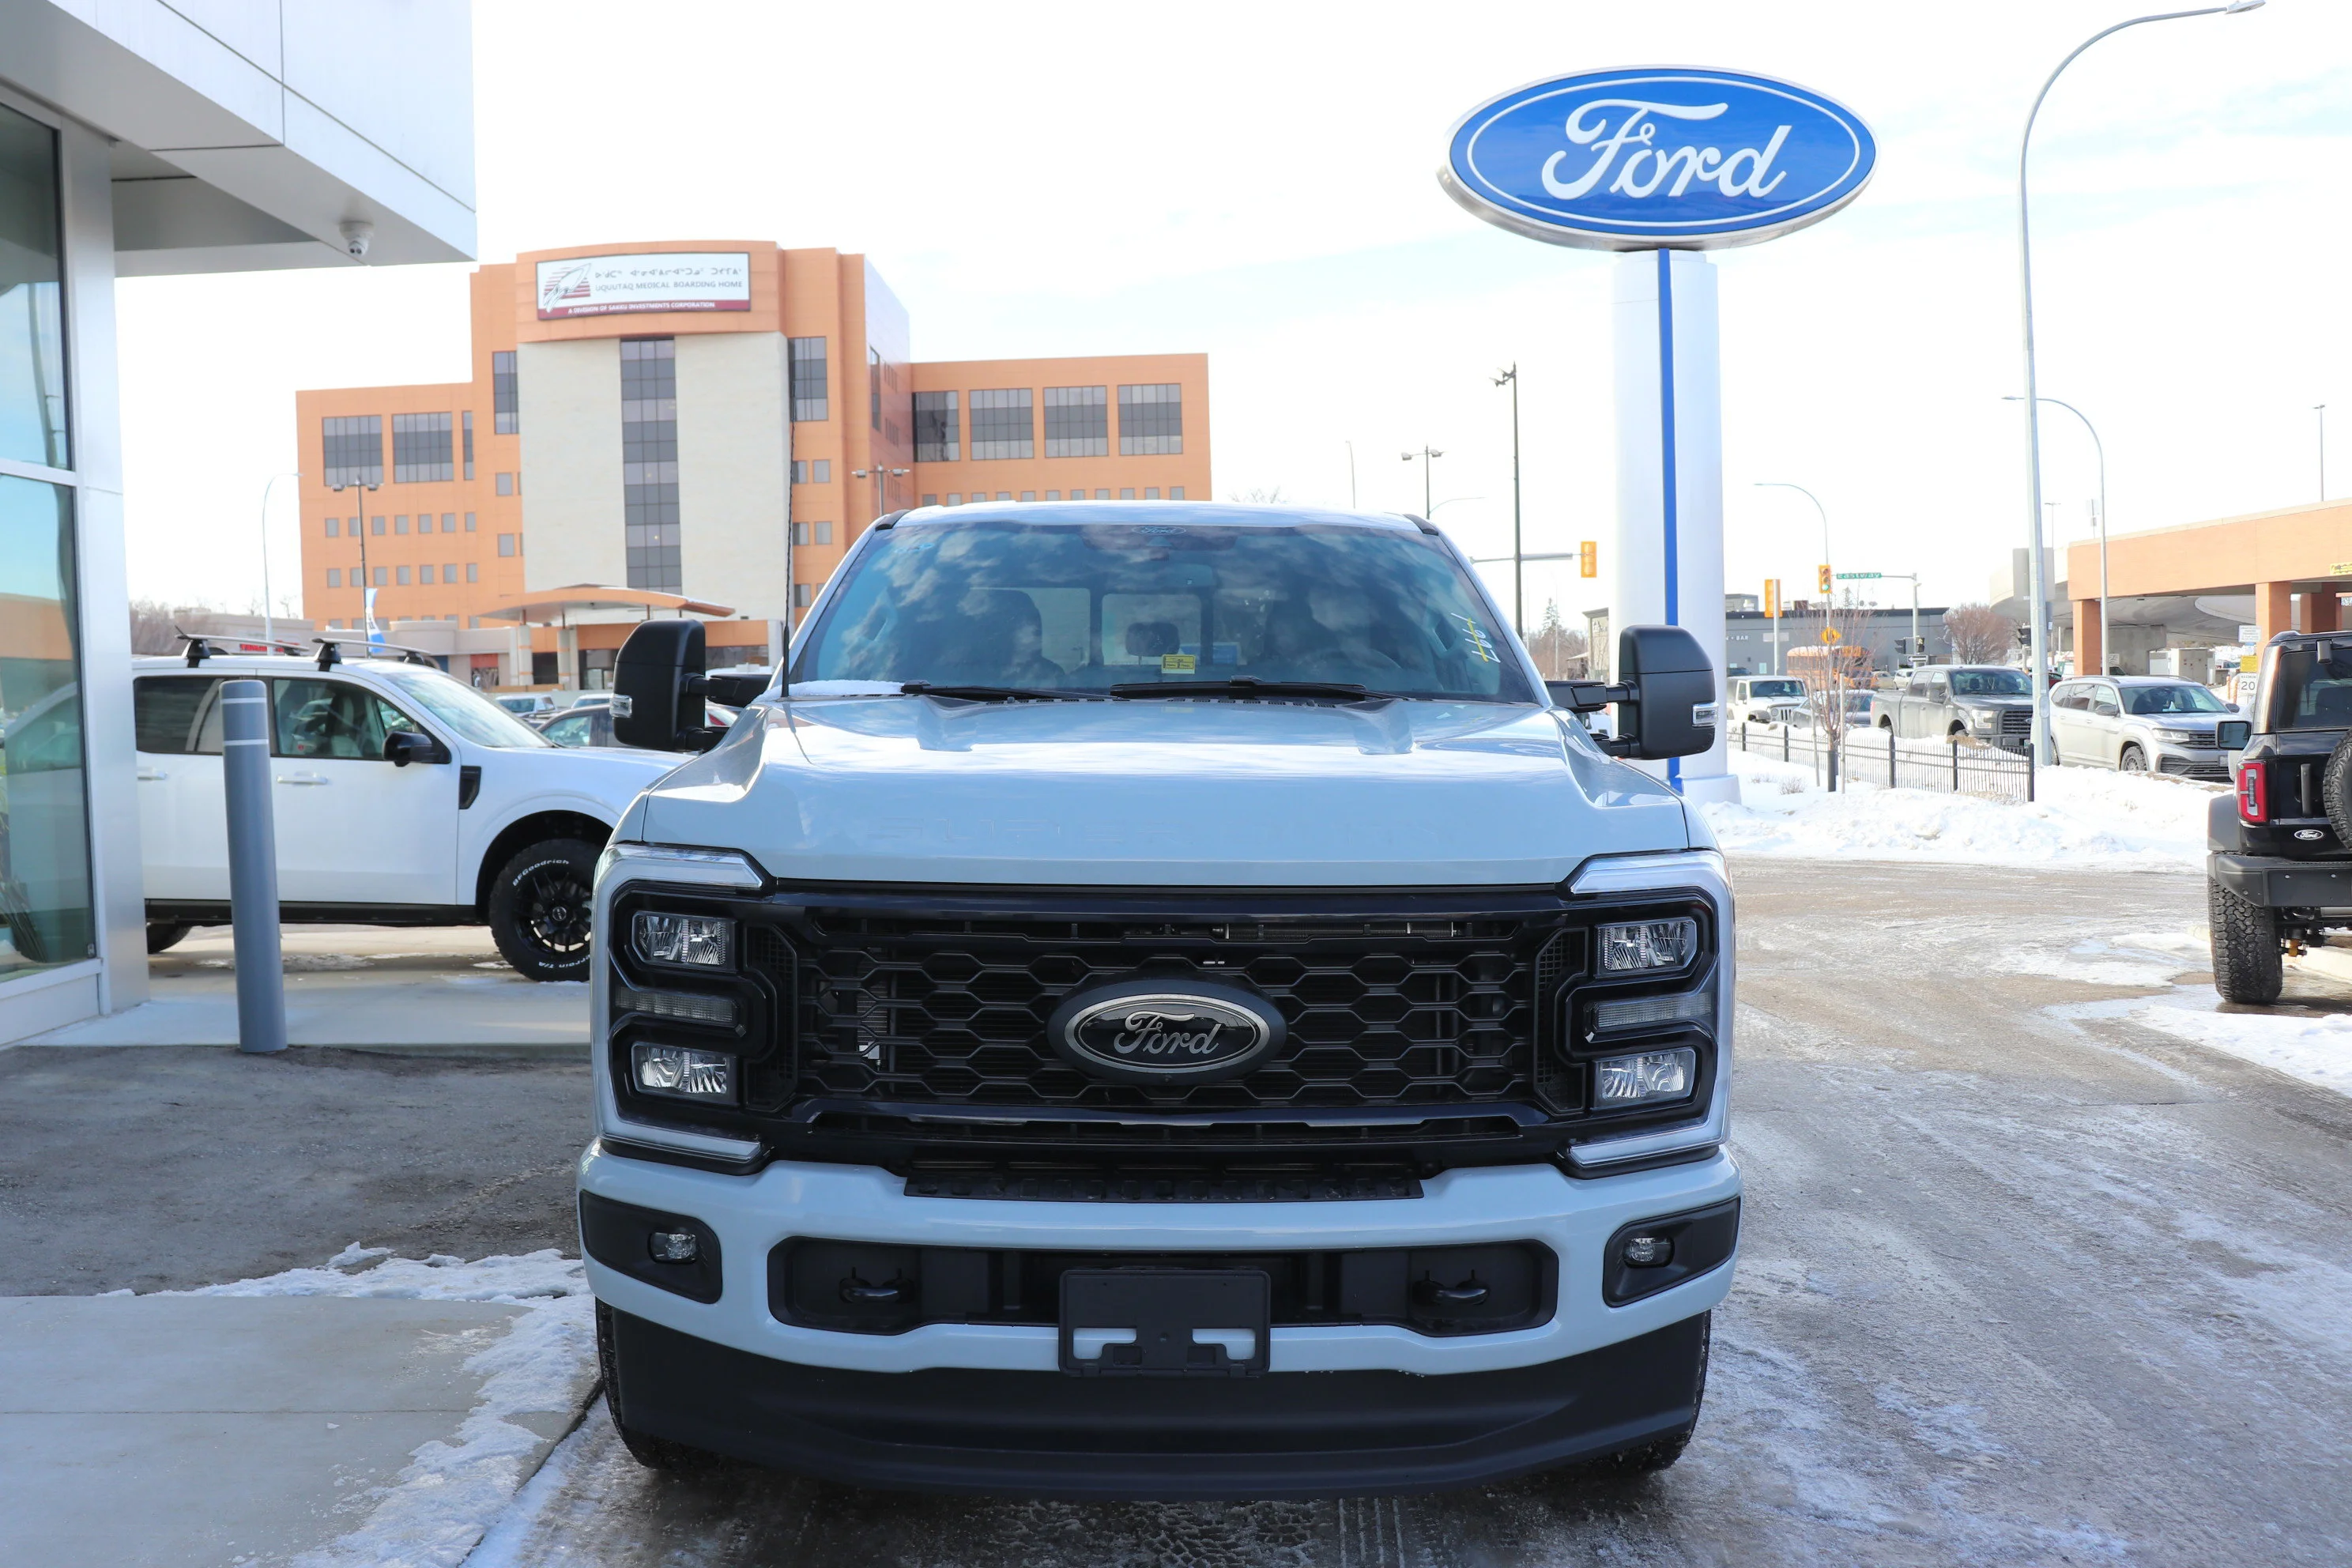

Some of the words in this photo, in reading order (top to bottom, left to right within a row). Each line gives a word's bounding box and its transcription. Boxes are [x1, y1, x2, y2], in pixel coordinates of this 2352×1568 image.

[1541, 98, 1792, 199] Ford
[2241, 681, 2256, 690] 20
[512, 859, 570, 887] BFGoodrich
[1114, 1010, 1223, 1054] Ford
